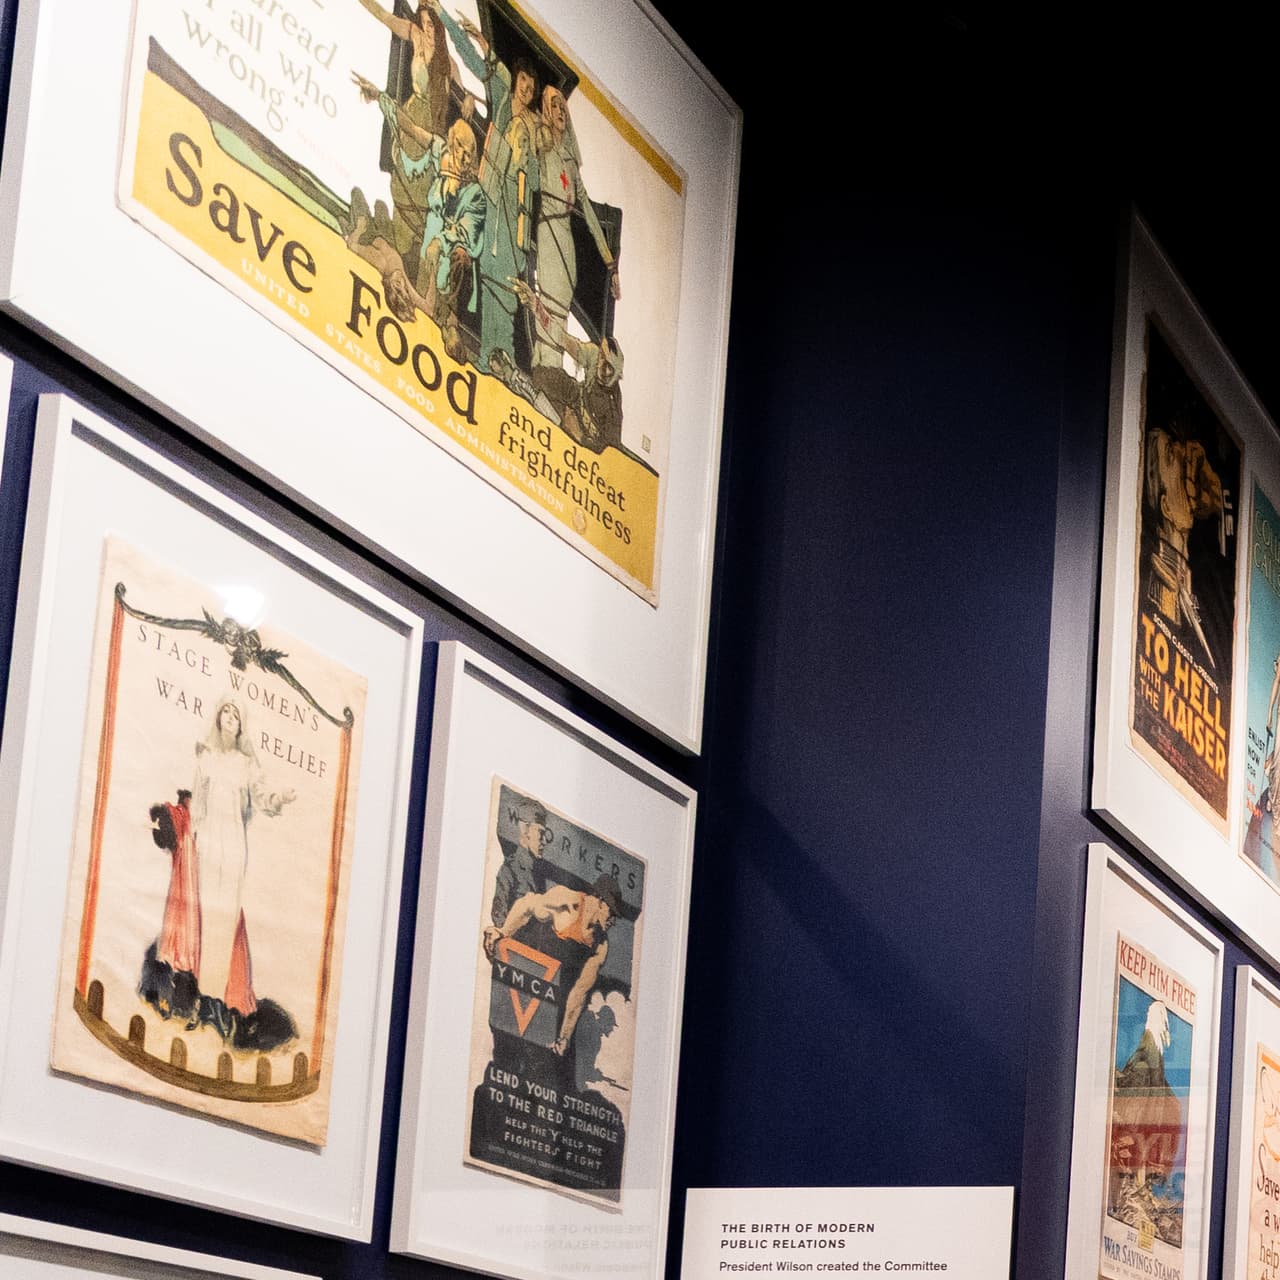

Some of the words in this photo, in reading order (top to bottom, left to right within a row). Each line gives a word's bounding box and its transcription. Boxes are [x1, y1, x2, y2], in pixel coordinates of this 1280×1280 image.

[230, 9, 264, 52] all
[279, 50, 338, 119] who
[165, 131, 317, 294] Save
[345, 269, 478, 426] Food
[240, 258, 311, 320] UNITED
[324, 322, 383, 374] STATES
[396, 376, 436, 415] FOOD
[445, 417, 566, 514] ADMINISTRATION
[497, 421, 632, 546] frightfulness
[509, 405, 553, 452] and
[563, 445, 627, 513] defeat
[137, 623, 213, 678] STAGE
[227, 669, 322, 732] WOMEN'S
[1140, 677, 1159, 712] THE
[1141, 612, 1169, 675] TO
[1174, 652, 1227, 742] HELL
[155, 676, 205, 720] WAR
[260, 730, 329, 779] RELIEF
[1139, 655, 1161, 692] WITH
[1163, 684, 1227, 781] KAISER
[1248, 727, 1266, 753] ENLIST
[1247, 744, 1260, 767] NOW
[497, 962, 556, 1001] YMCA
[1119, 939, 1147, 980] KEEP
[1149, 961, 1168, 997] HIM
[1171, 978, 1197, 1016] FREE
[489, 1067, 520, 1089] LEND
[525, 1080, 558, 1105] YOUR
[562, 1095, 620, 1126] STRENGTH
[489, 1087, 504, 1103] TO
[508, 1094, 531, 1113] THE
[537, 1105, 564, 1124] RED
[569, 1116, 619, 1143] TRIANGLE
[504, 1131, 560, 1156] FIGHTERS
[566, 1151, 602, 1170] FIGHT
[505, 1116, 527, 1130] HELP
[530, 1124, 547, 1137] THE
[562, 1136, 584, 1150] HELP
[587, 1144, 603, 1157] THE
[1256, 1143, 1280, 1201] Save
[720, 1239, 769, 1250] PUBLIC
[772, 1238, 846, 1249] RELATIONS
[721, 1223, 747, 1234] THE
[750, 1223, 791, 1234] BIRTH
[794, 1223, 814, 1234] OF
[817, 1223, 875, 1234] MODERN
[1264, 1208, 1270, 1227] a
[719, 1260, 774, 1272] President
[775, 1260, 814, 1272] Wilson
[815, 1261, 860, 1272] created
[862, 1260, 882, 1272] the
[884, 1260, 948, 1272] Committee
[1103, 1235, 1121, 1262] WAR
[1122, 1245, 1153, 1276] SAVINGS
[1259, 1233, 1280, 1278] help
